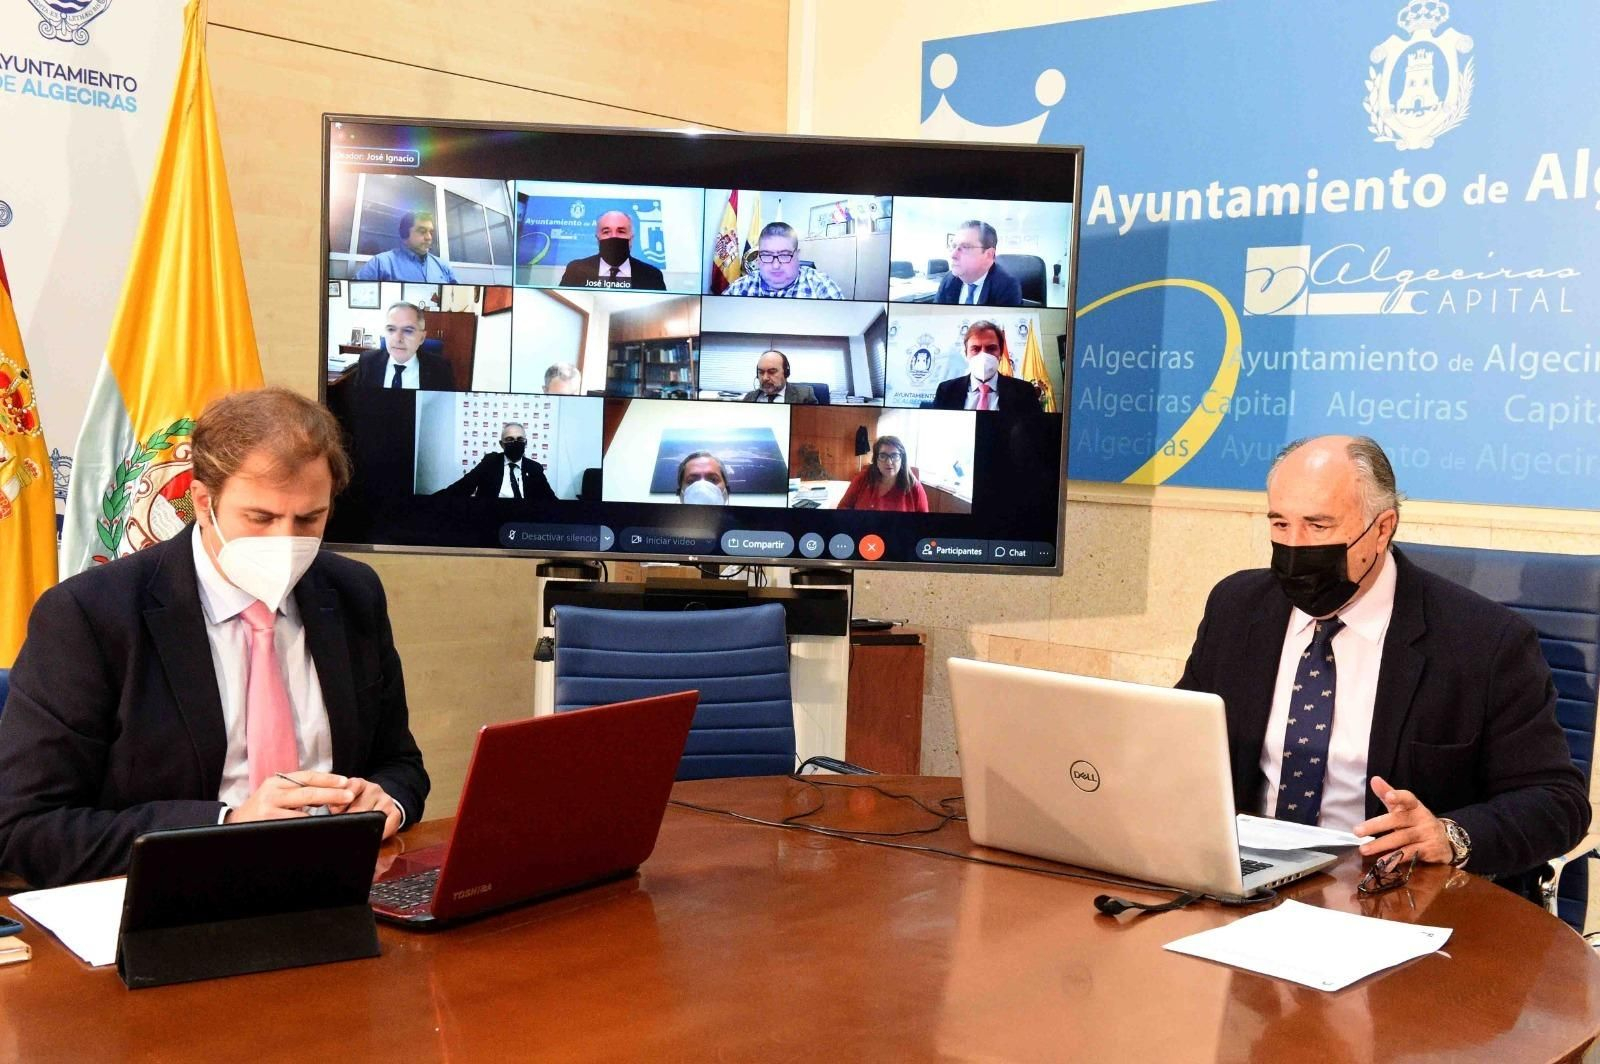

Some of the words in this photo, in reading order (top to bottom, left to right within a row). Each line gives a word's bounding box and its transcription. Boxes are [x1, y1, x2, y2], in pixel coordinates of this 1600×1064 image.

[0, 53, 137, 92] YUNTAMIENTO
[21, 78, 137, 113] ALGECIRAS
[366, 153, 384, 161] José
[385, 154, 415, 164] Ignacio
[1087, 168, 1447, 236] Ayuntamiento
[1463, 174, 1509, 205] de
[1524, 148, 1600, 211] Al
[585, 279, 602, 287] José
[603, 280, 631, 289] Ignacio
[1410, 287, 1574, 315] CAPITAL
[1080, 343, 1195, 375] Algeciras
[1227, 343, 1439, 377] Ayuntamiento
[1448, 353, 1473, 373] de
[1079, 386, 1192, 418] Algeciras
[1202, 388, 1296, 422] Capital
[1327, 391, 1468, 425] Algeciras
[1504, 394, 1600, 431] Capit
[1076, 427, 1189, 459] Algeciras
[1440, 450, 1466, 470] de
[521, 531, 563, 542] Desactivar
[566, 533, 598, 543] silencio
[645, 536, 672, 546] Iniciar
[742, 539, 785, 550] Compartir
[936, 546, 982, 557] Participantes
[1009, 548, 1026, 557] Chat
[1073, 770, 1098, 782] DELL
